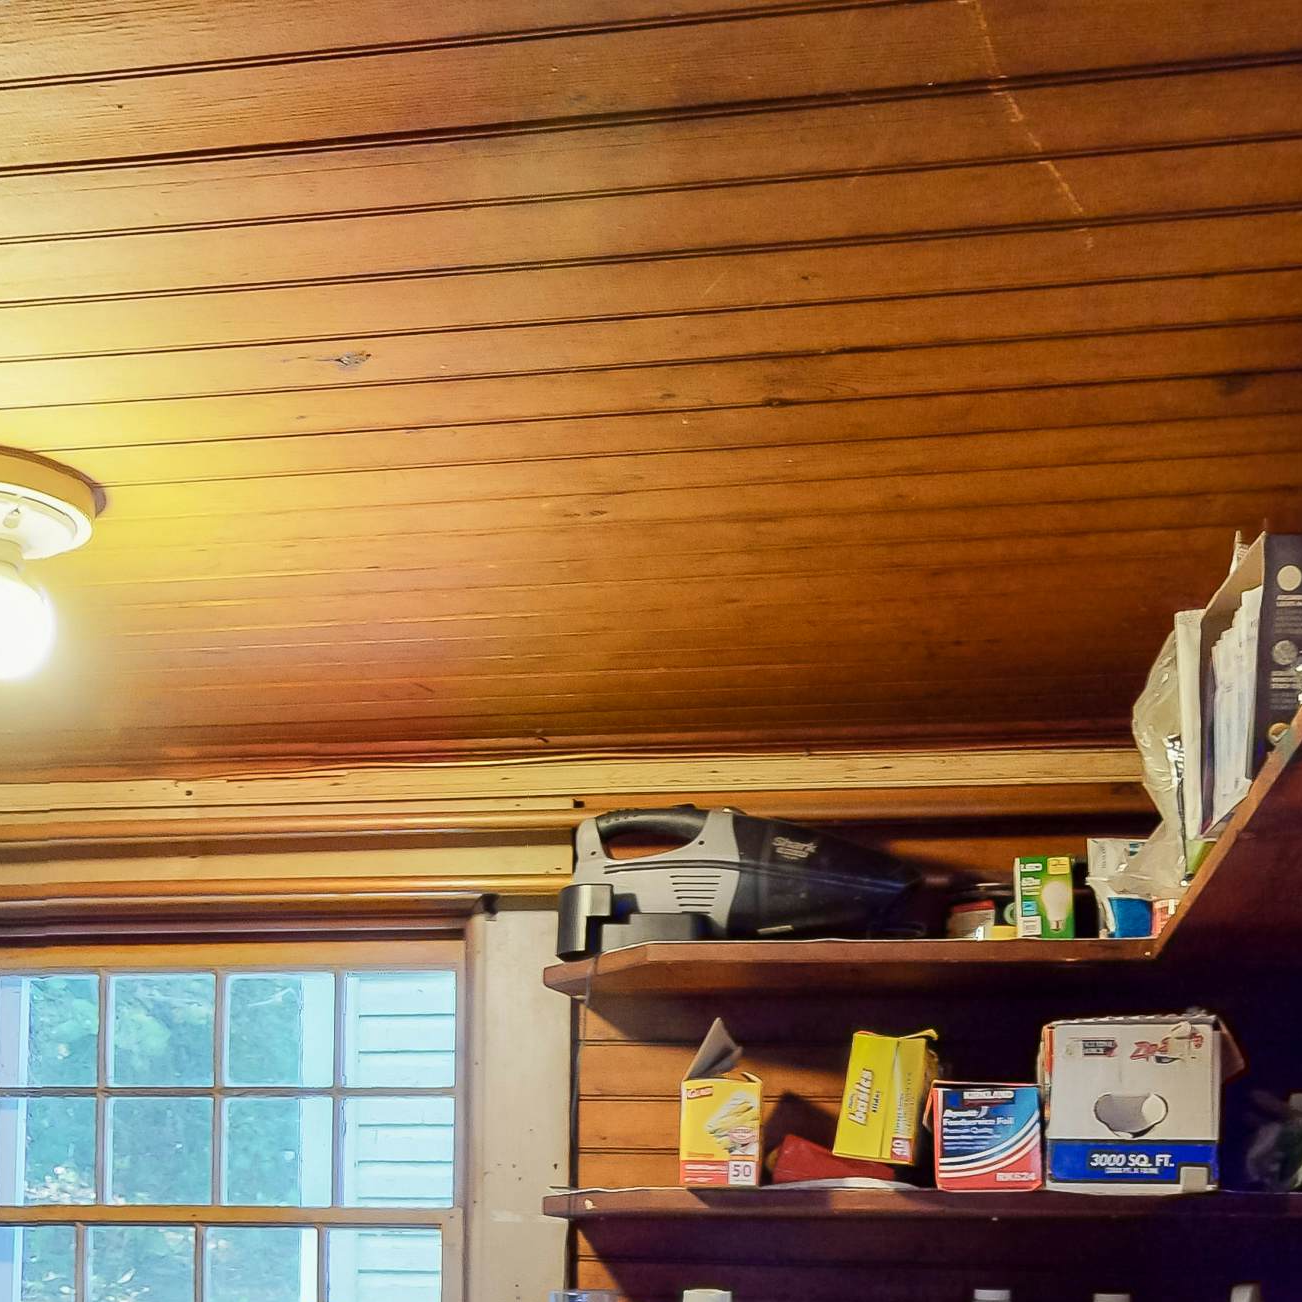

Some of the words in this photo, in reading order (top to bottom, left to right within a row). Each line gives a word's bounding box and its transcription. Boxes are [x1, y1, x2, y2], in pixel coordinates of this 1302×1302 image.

[1089, 1153, 1127, 1167] 3000
[1155, 1154, 1175, 1167] FT.
[732, 1164, 752, 1177] 50
